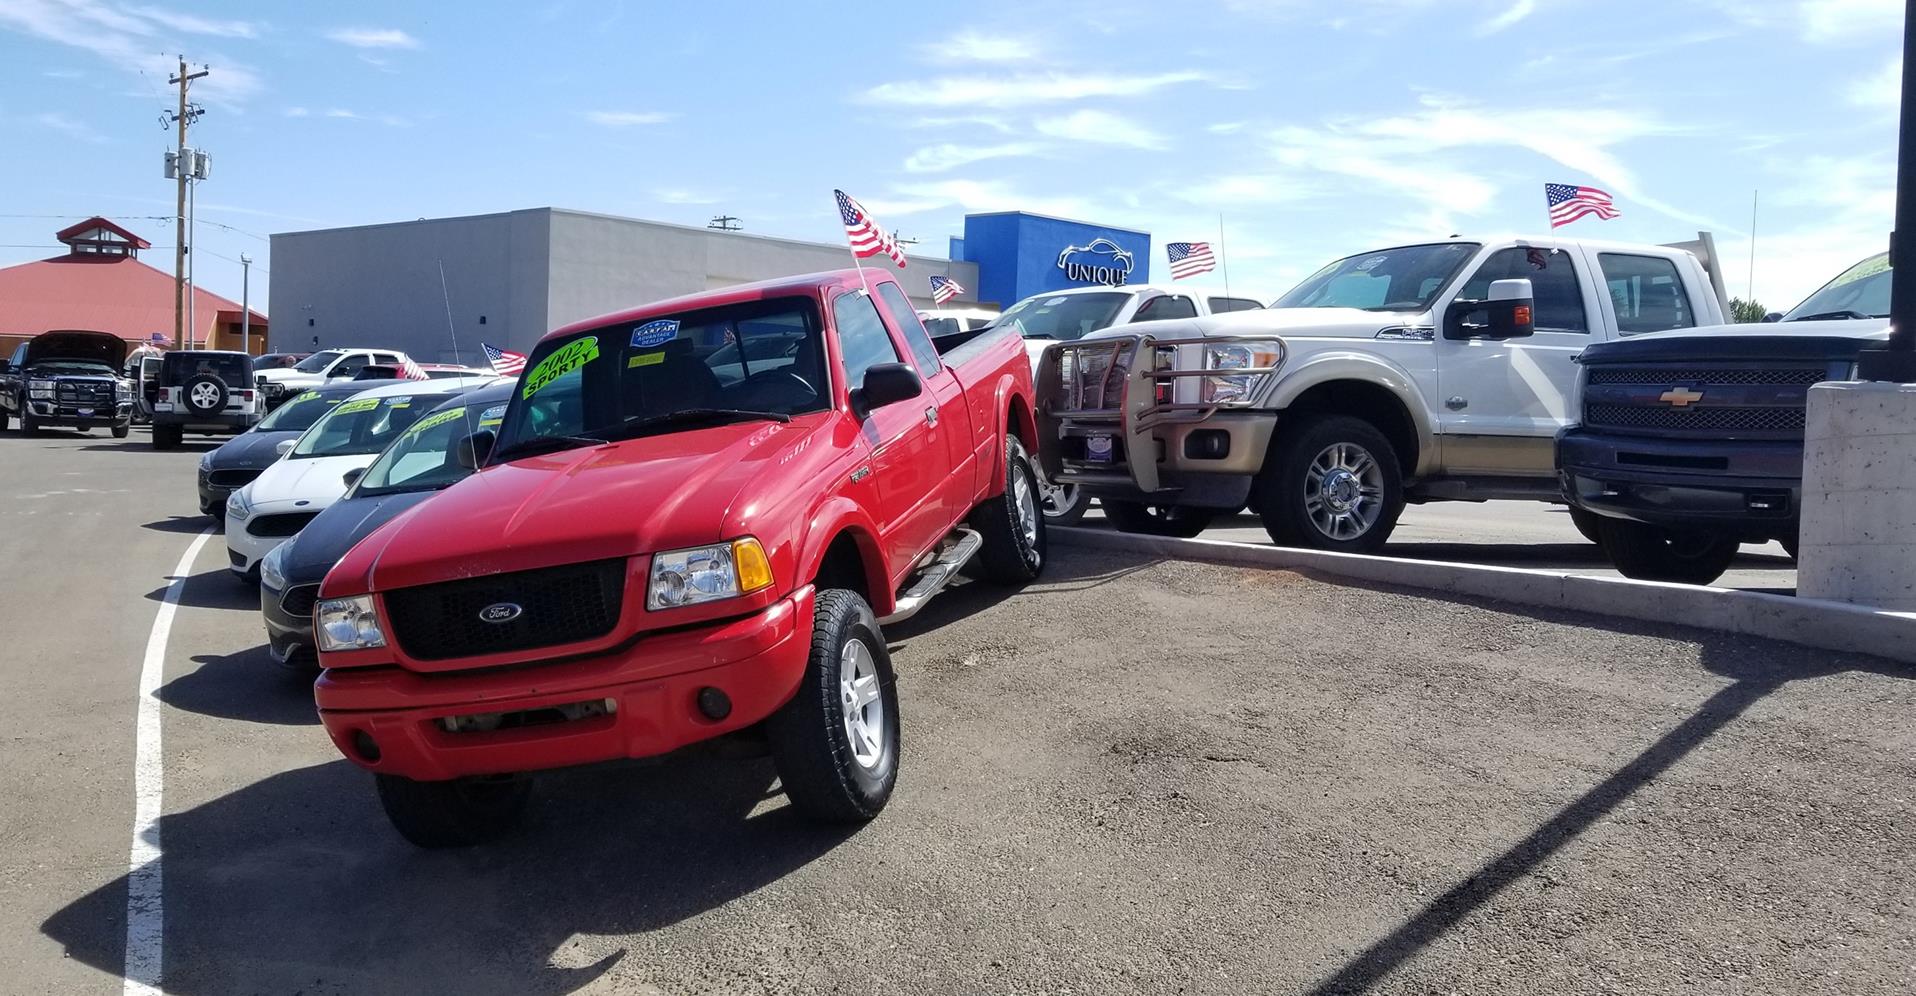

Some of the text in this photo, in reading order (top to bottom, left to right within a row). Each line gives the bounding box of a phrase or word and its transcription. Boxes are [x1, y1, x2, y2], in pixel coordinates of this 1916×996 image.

[1067, 262, 1128, 287] UNIQUE
[527, 349, 592, 395] SPORTY
[535, 341, 584, 381] 2002
[489, 606, 511, 619] Ford
